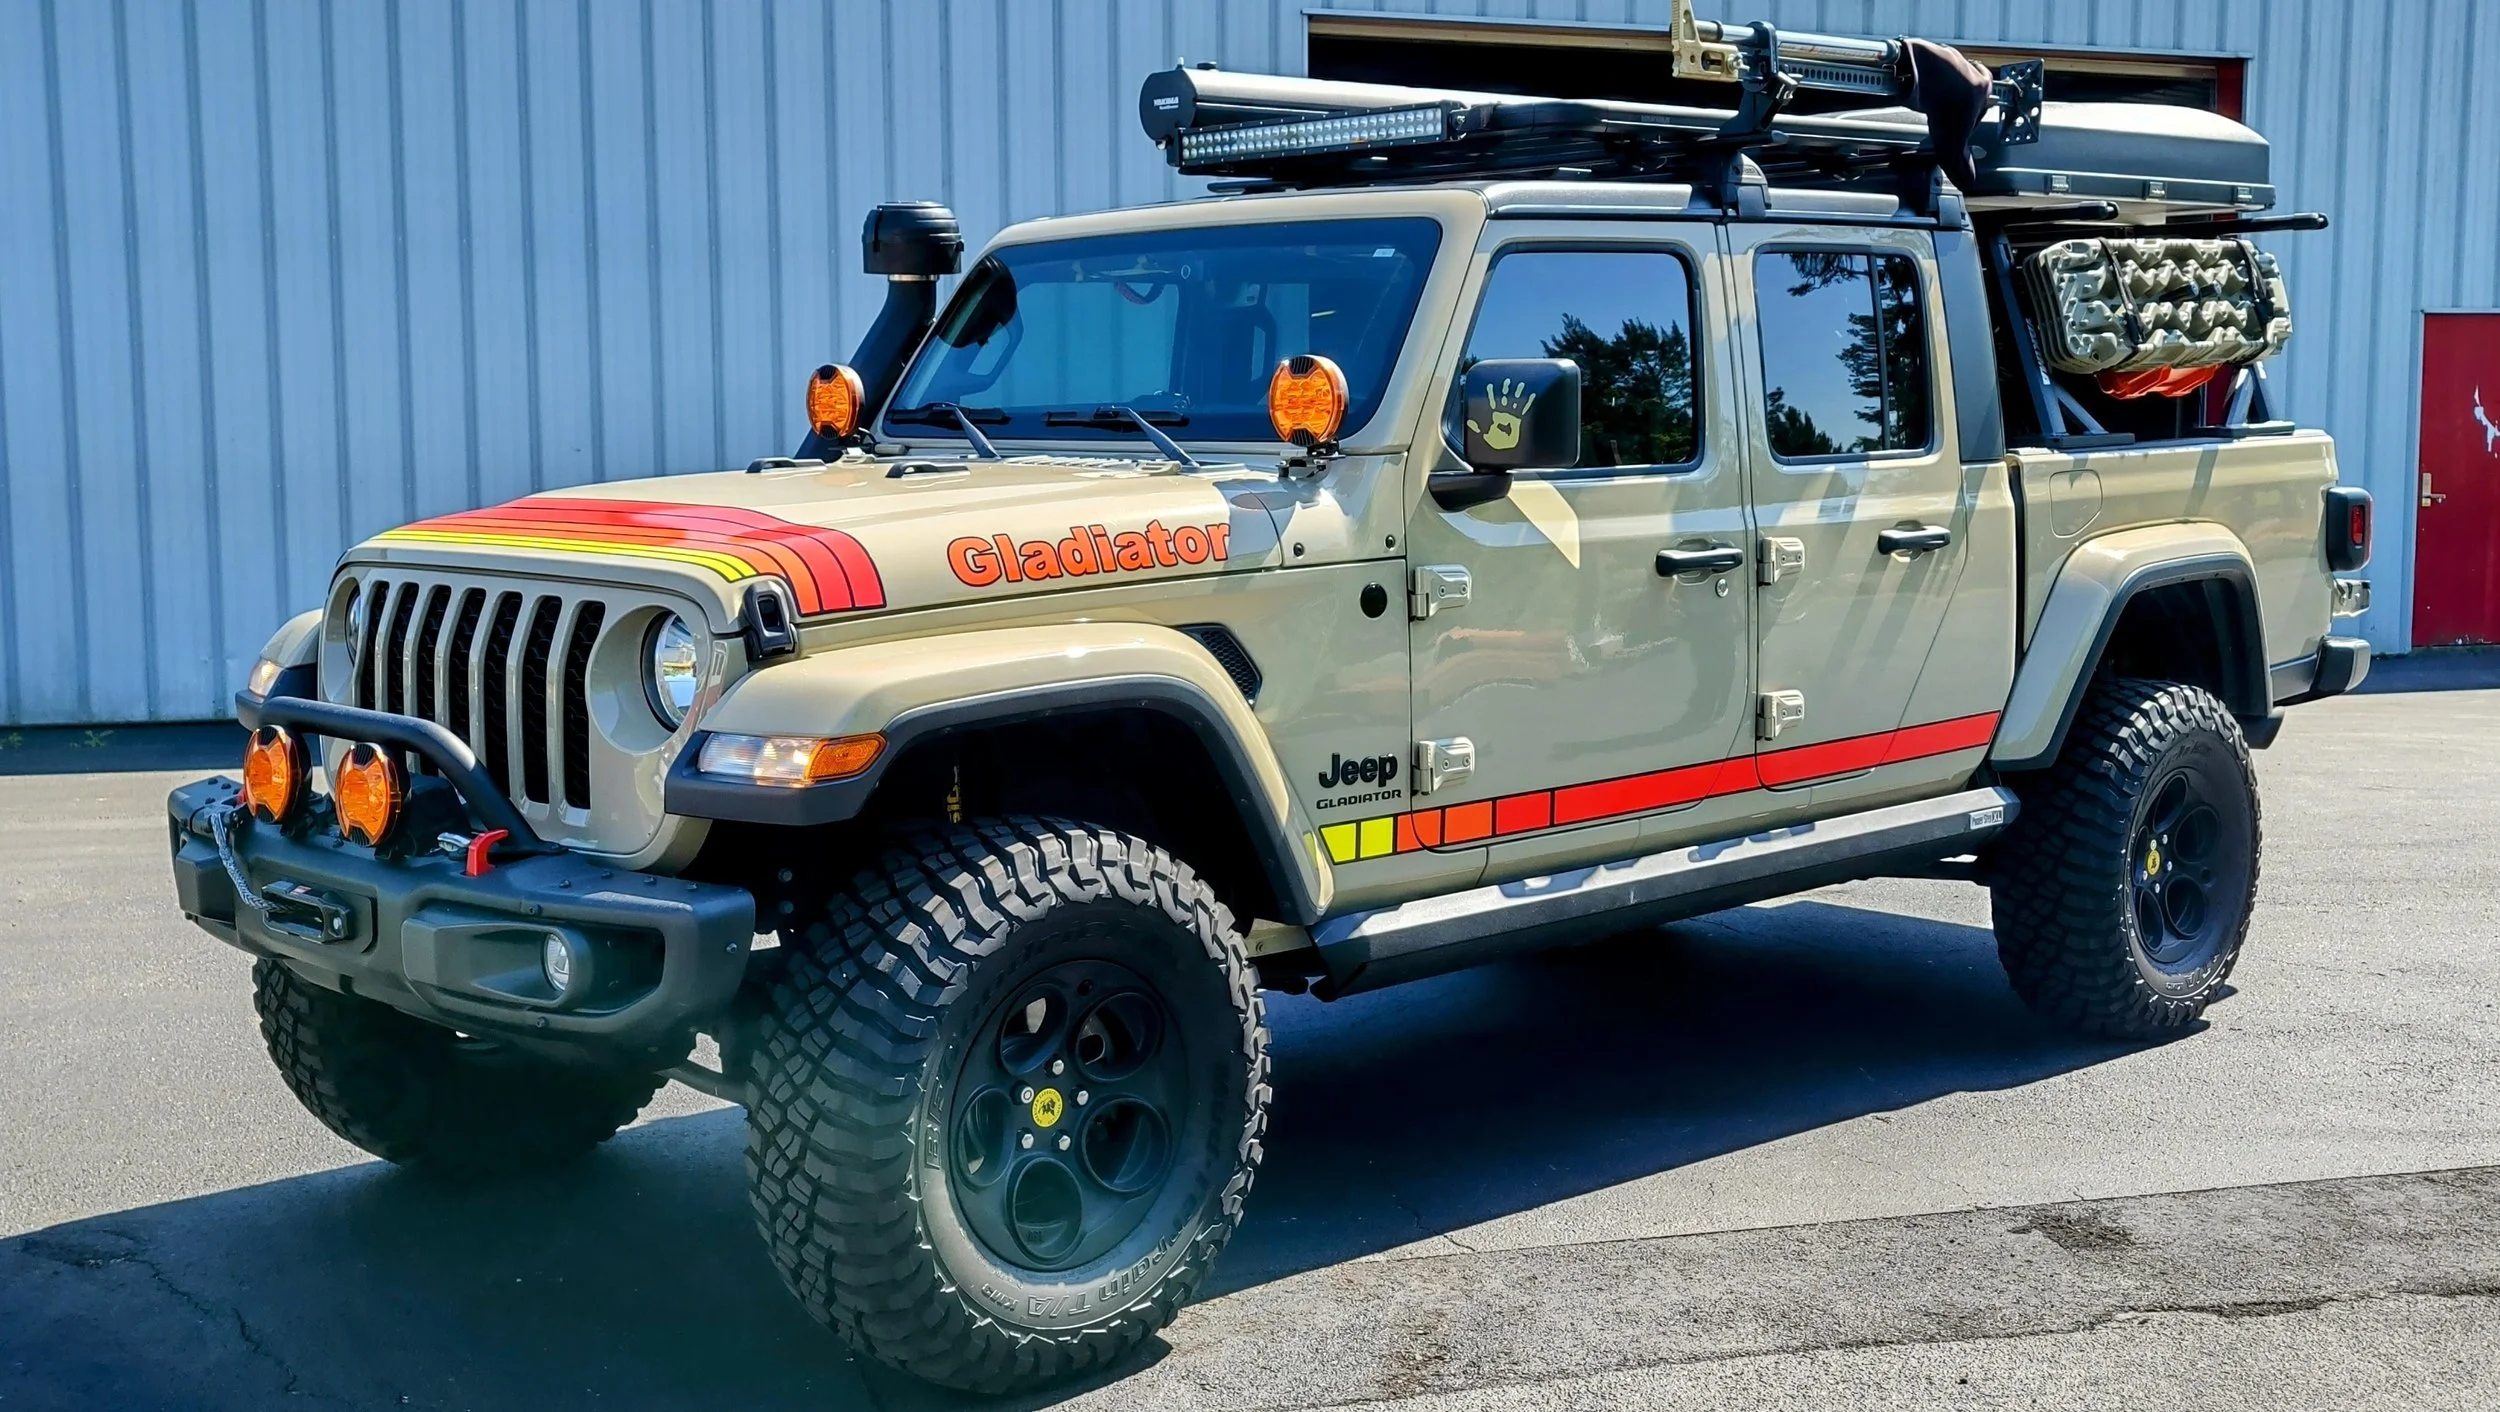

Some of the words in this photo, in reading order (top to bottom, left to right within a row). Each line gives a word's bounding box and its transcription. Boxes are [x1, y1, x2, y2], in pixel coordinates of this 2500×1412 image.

[947, 519, 1231, 587] Gladiator
[1318, 752, 1398, 789] Jeep
[1316, 789, 1402, 810] GLADIATOR
